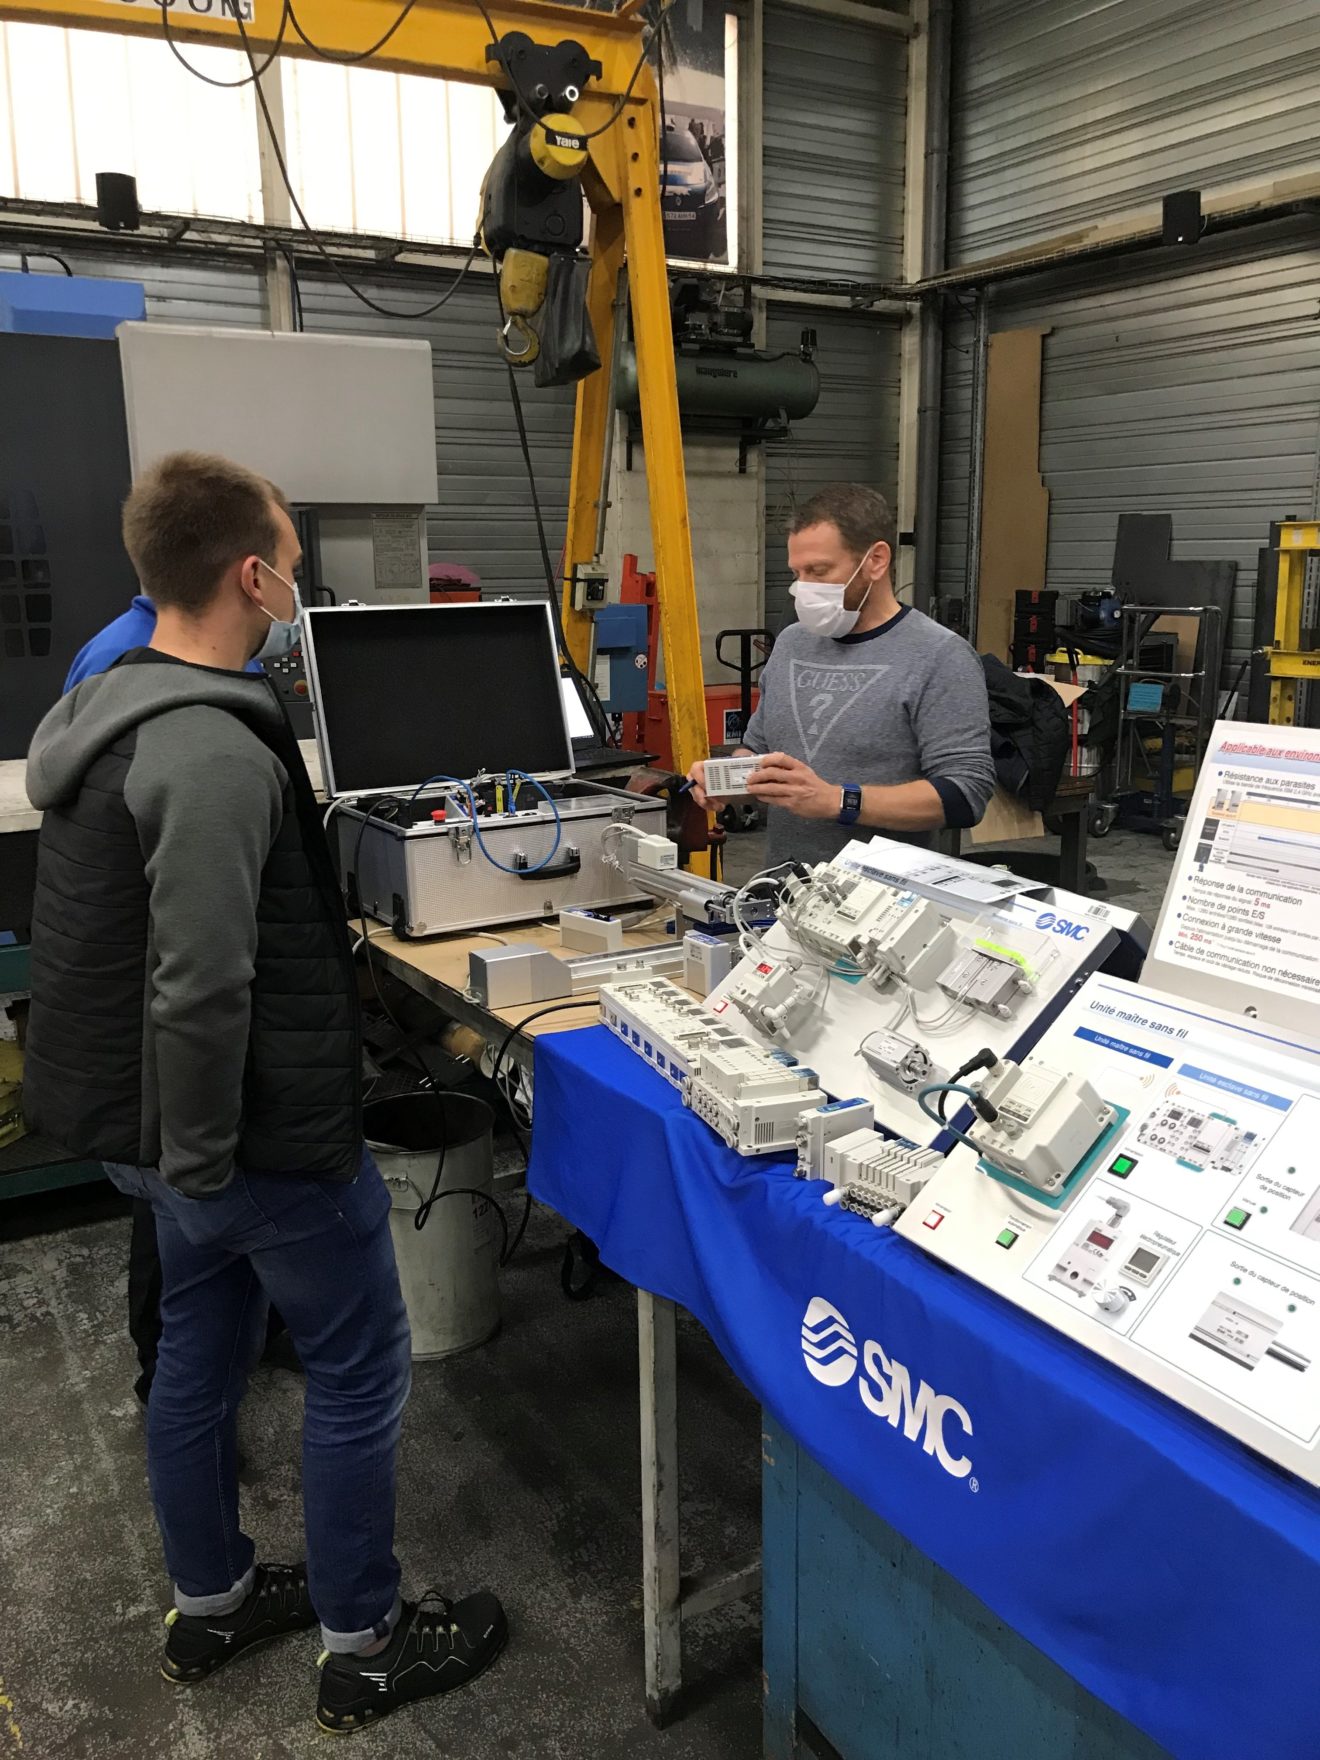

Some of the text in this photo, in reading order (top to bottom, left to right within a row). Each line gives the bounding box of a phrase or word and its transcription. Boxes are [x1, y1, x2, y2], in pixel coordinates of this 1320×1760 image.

[797, 669, 867, 692] GUESS
[1220, 740, 1320, 760] Applicable aux environ
[1223, 770, 1316, 792] Résistance aux parasites
[1192, 875, 1302, 905] Réponse de la communication
[1253, 897, 1260, 906] 5
[1187, 895, 1216, 908] Nombre
[1216, 902, 1226, 911] de
[1226, 904, 1250, 916] points
[1250, 909, 1265, 920] E/S
[1052, 919, 1089, 941] SMC
[1181, 912, 1220, 928] Connexion
[1220, 921, 1226, 930] à
[1226, 924, 1254, 938] grande
[1254, 930, 1282, 943] vitesse
[1189, 932, 1203, 942] 250
[1174, 940, 1195, 952] Câble
[1195, 946, 1205, 955] de
[1205, 949, 1260, 970] communication
[1261, 964, 1276, 974] non
[1090, 1000, 1189, 1039] Unité maître sans fil
[1095, 1034, 1109, 1045] Unité
[1256, 1173, 1273, 1184] Sortie
[1282, 1185, 1305, 1197] capteur
[1267, 1188, 1291, 1200] position
[1229, 1259, 1316, 1306] Sortie du capteur de position
[859, 1339, 973, 1478] SMC
